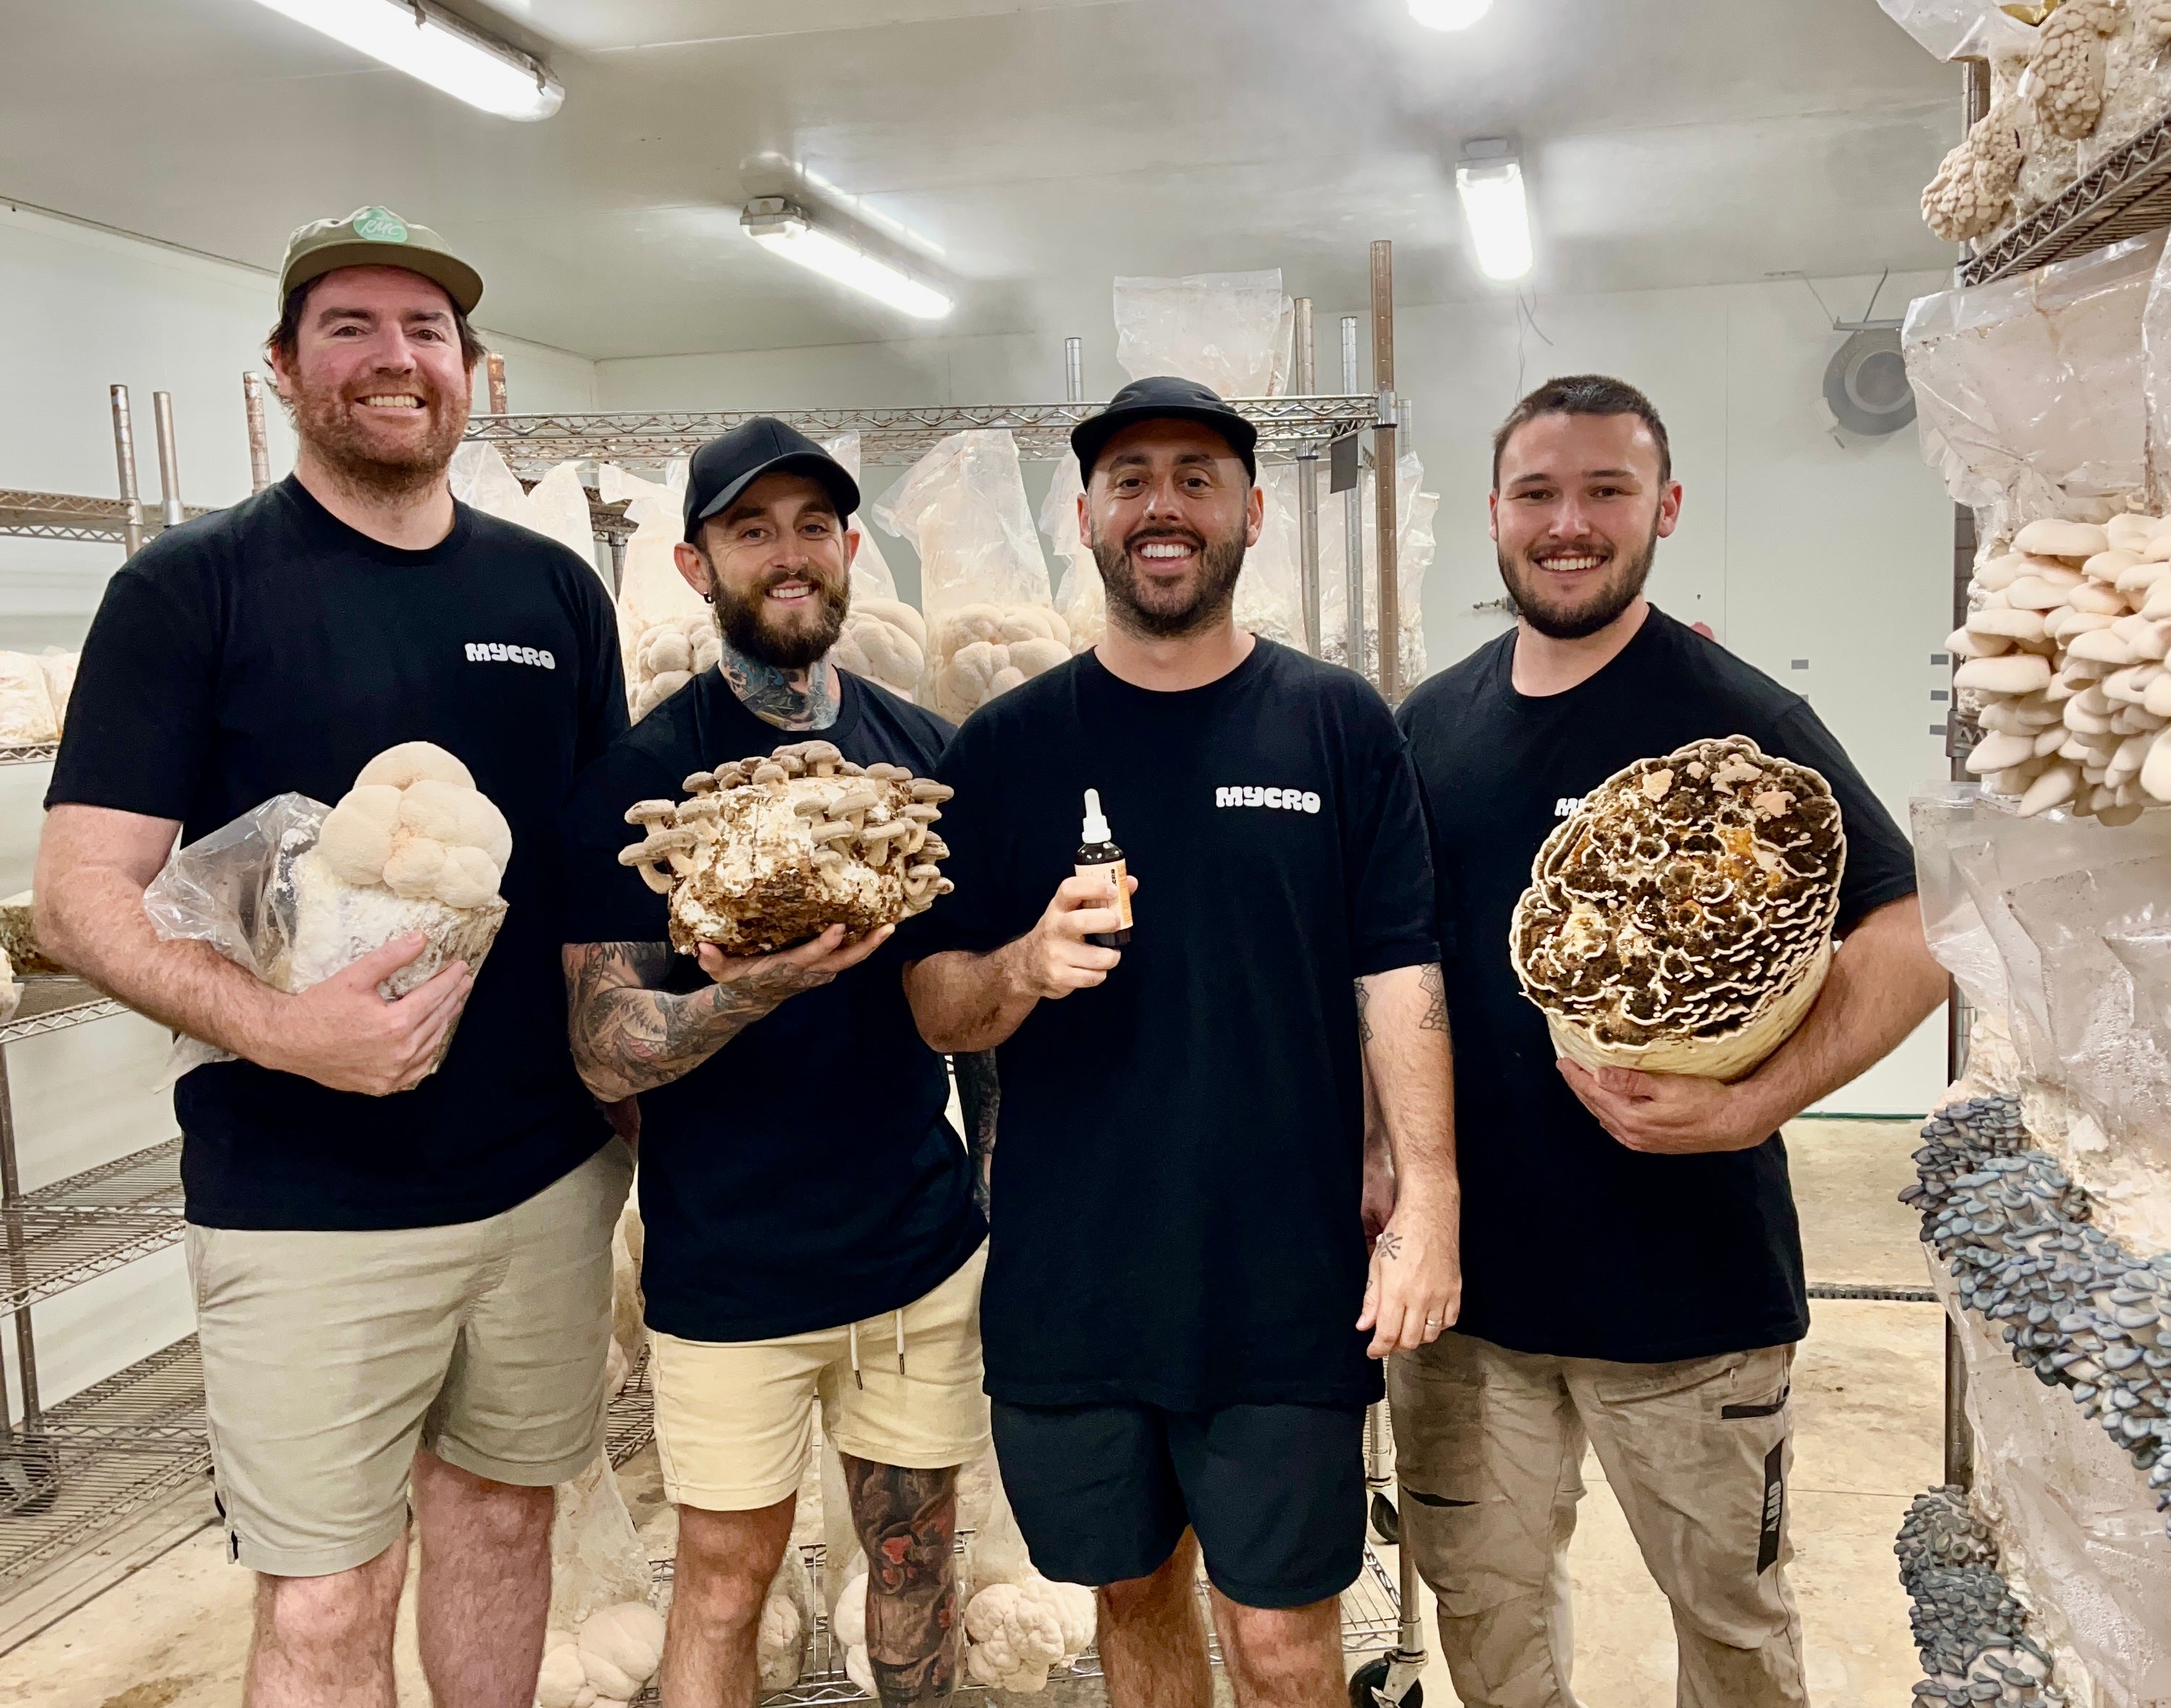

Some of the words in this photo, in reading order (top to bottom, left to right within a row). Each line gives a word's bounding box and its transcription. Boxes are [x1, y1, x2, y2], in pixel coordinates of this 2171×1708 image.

[360, 219, 401, 236] RMC
[464, 642, 556, 670] MYCRO
[1216, 786, 1321, 814] MYCRO
